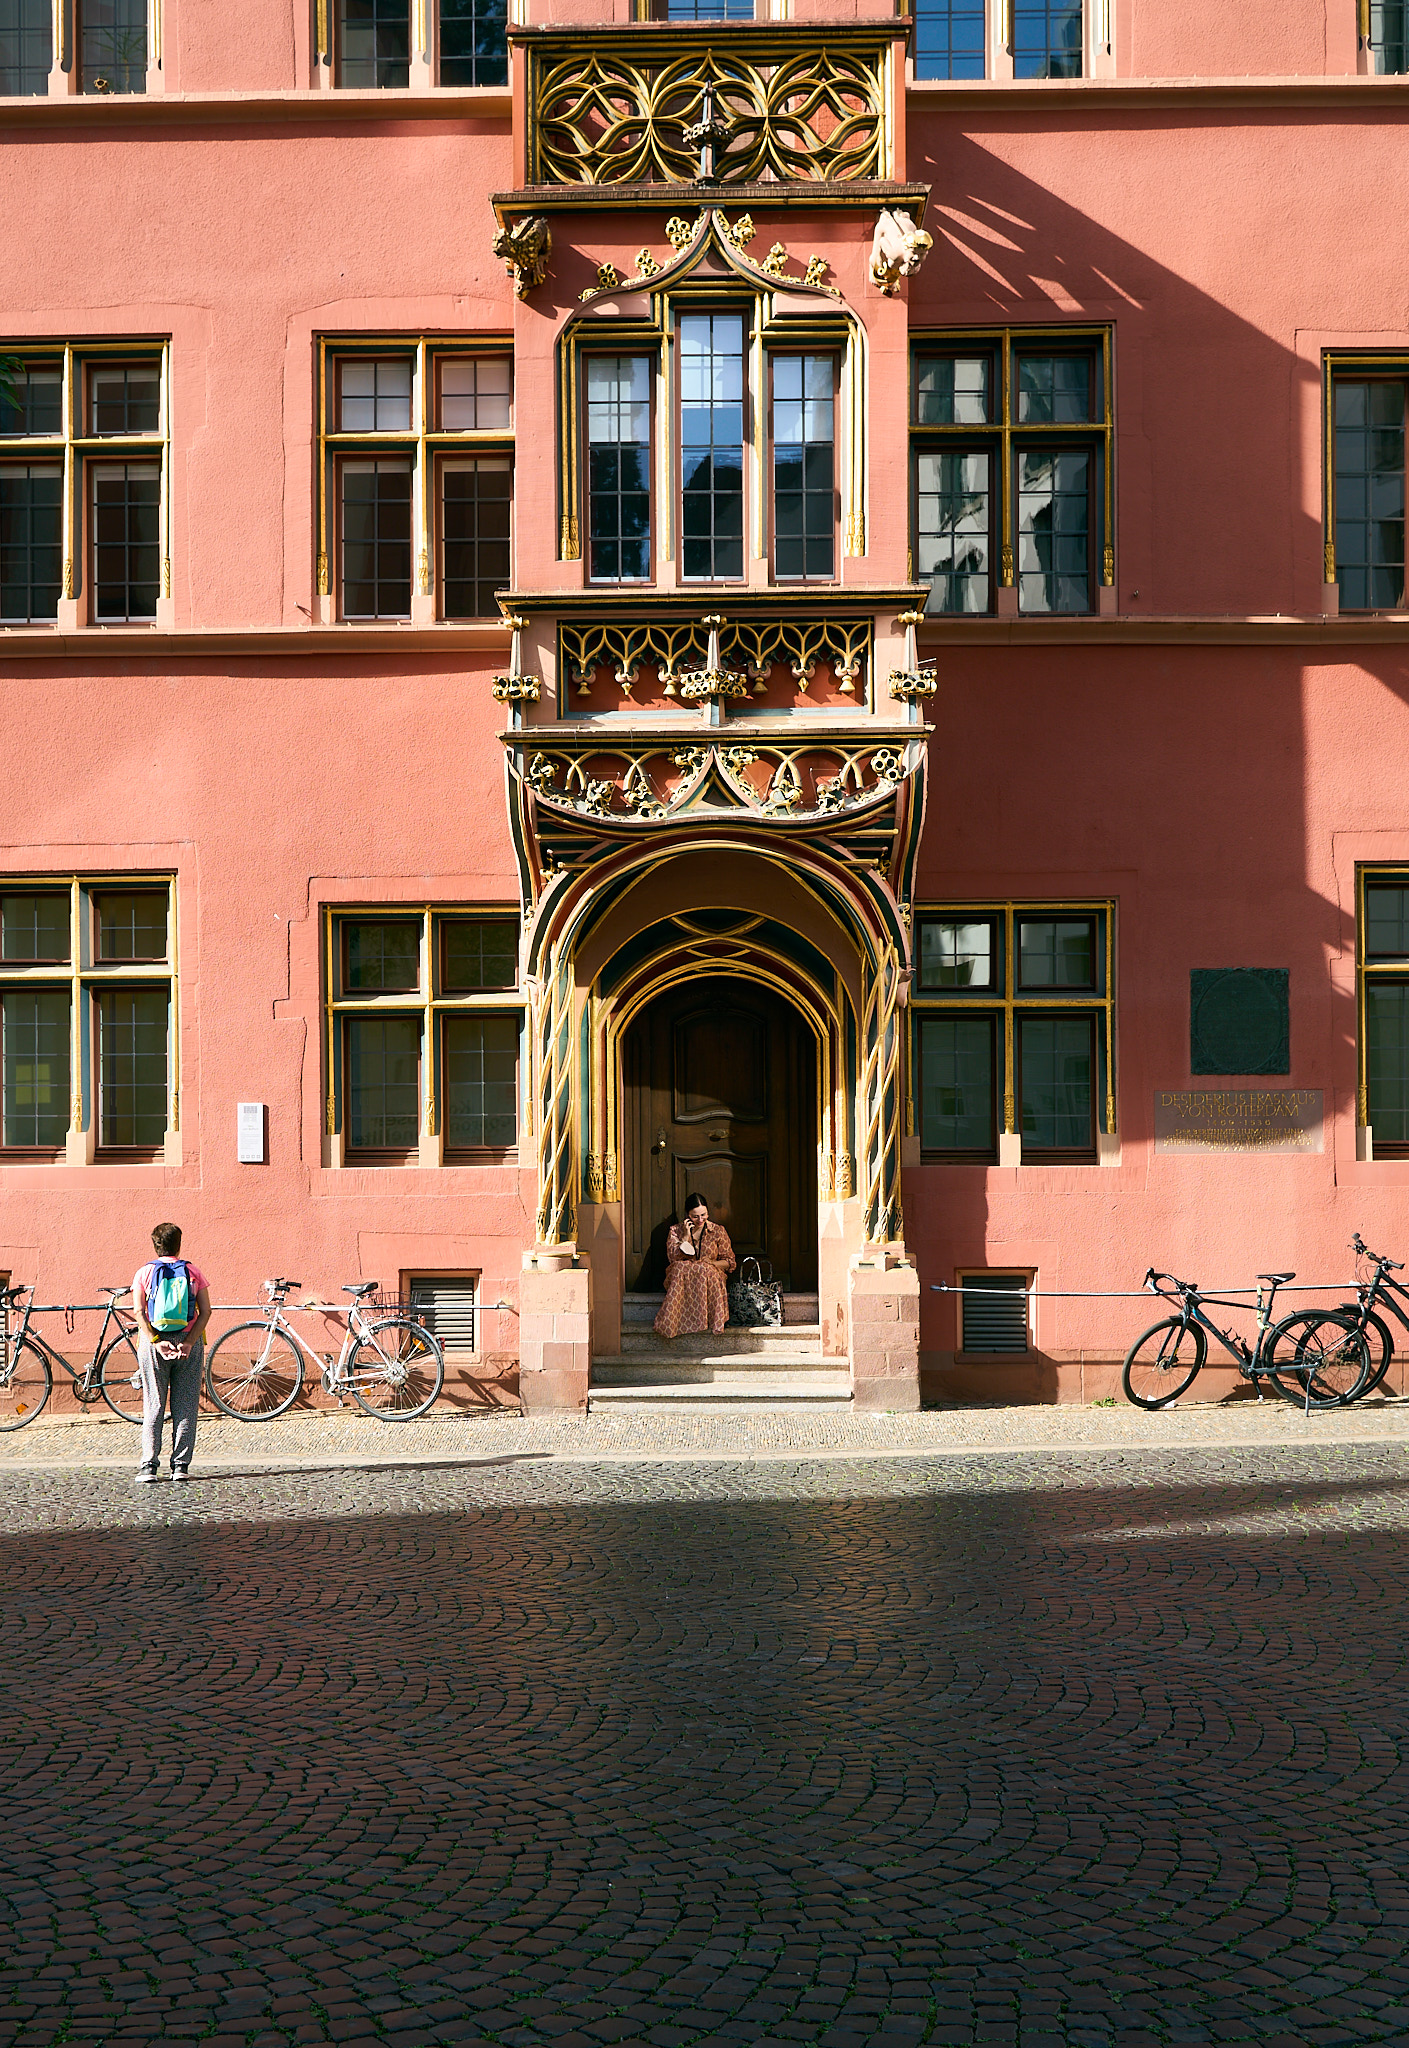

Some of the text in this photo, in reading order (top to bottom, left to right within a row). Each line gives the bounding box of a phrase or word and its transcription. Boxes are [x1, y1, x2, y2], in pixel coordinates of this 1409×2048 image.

[1161, 1093, 1316, 1106] DESIDERIUS ERASMUS
[1178, 1104, 1299, 1118] VON ROTTERDAM
